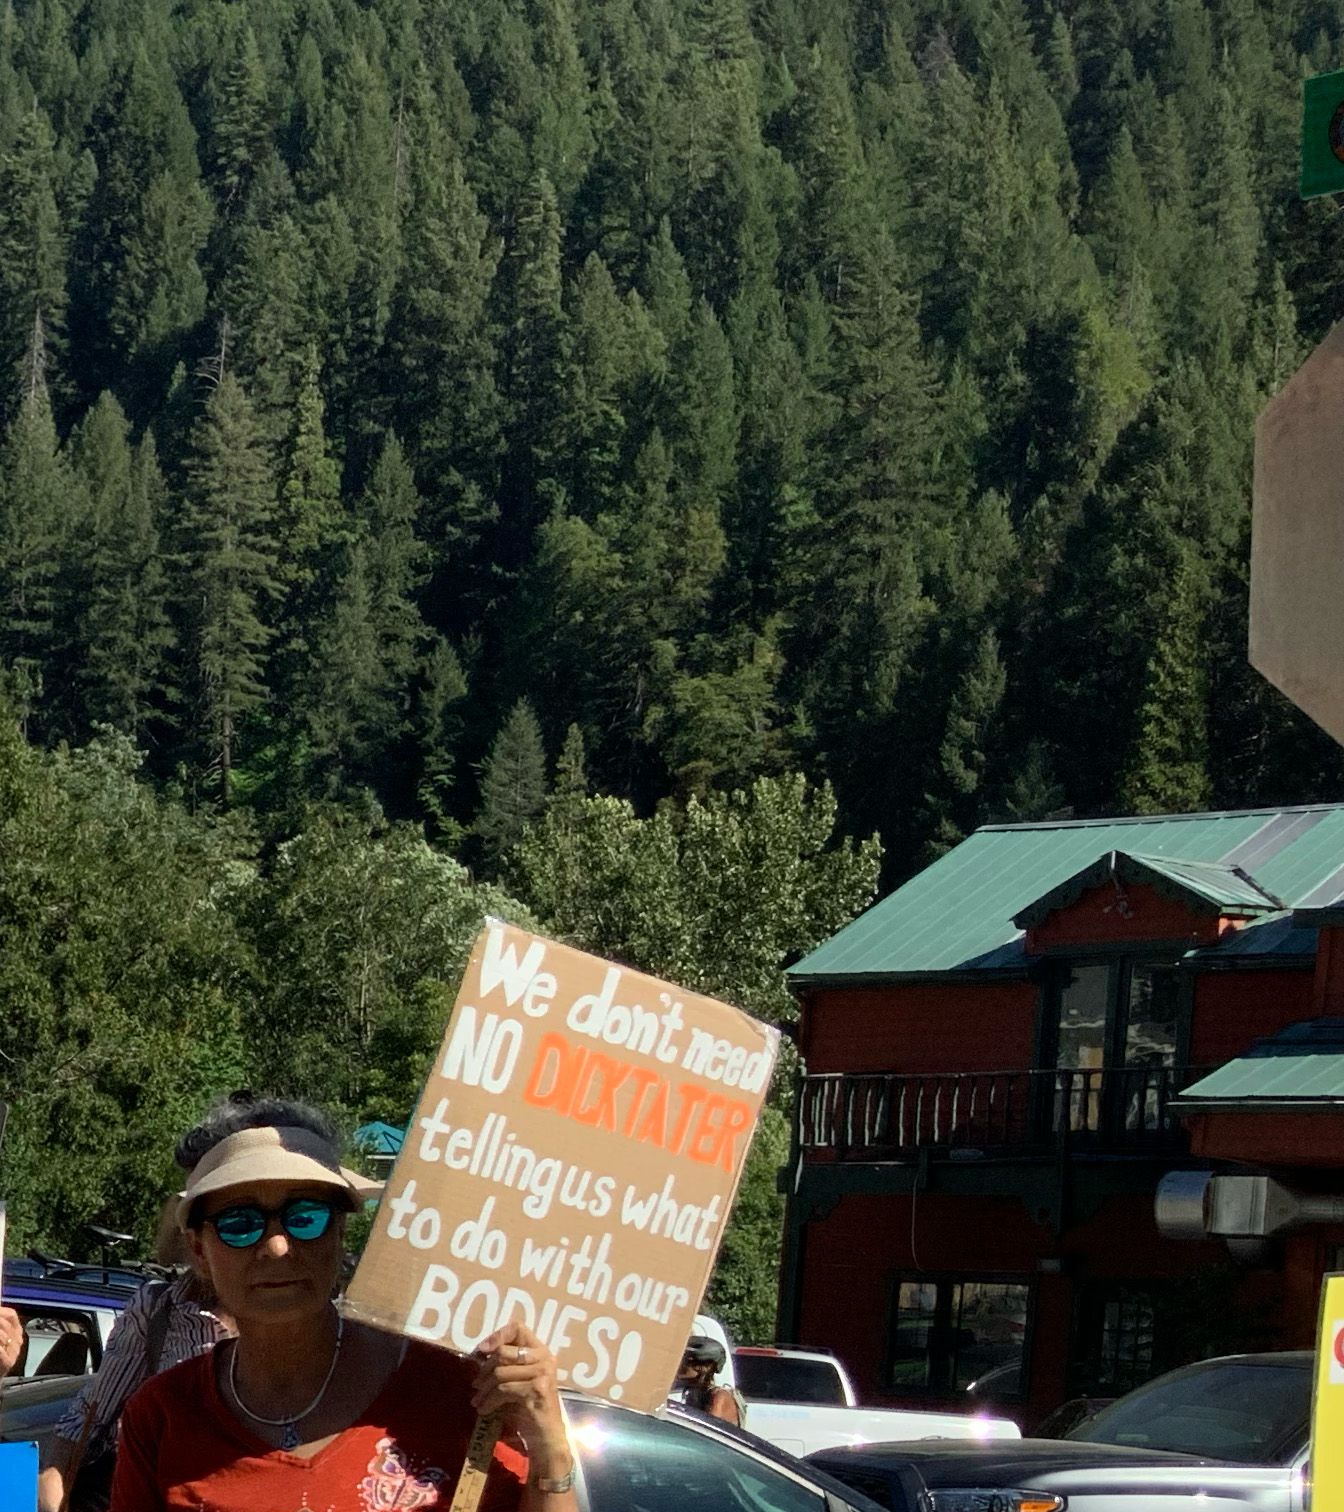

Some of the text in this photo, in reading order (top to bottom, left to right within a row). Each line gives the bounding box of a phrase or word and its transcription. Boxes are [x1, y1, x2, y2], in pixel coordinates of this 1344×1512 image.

[441, 1006, 524, 1094] NO
[479, 926, 772, 1094] We don't need
[386, 1180, 689, 1325] to do with our
[622, 1174, 721, 1251] what
